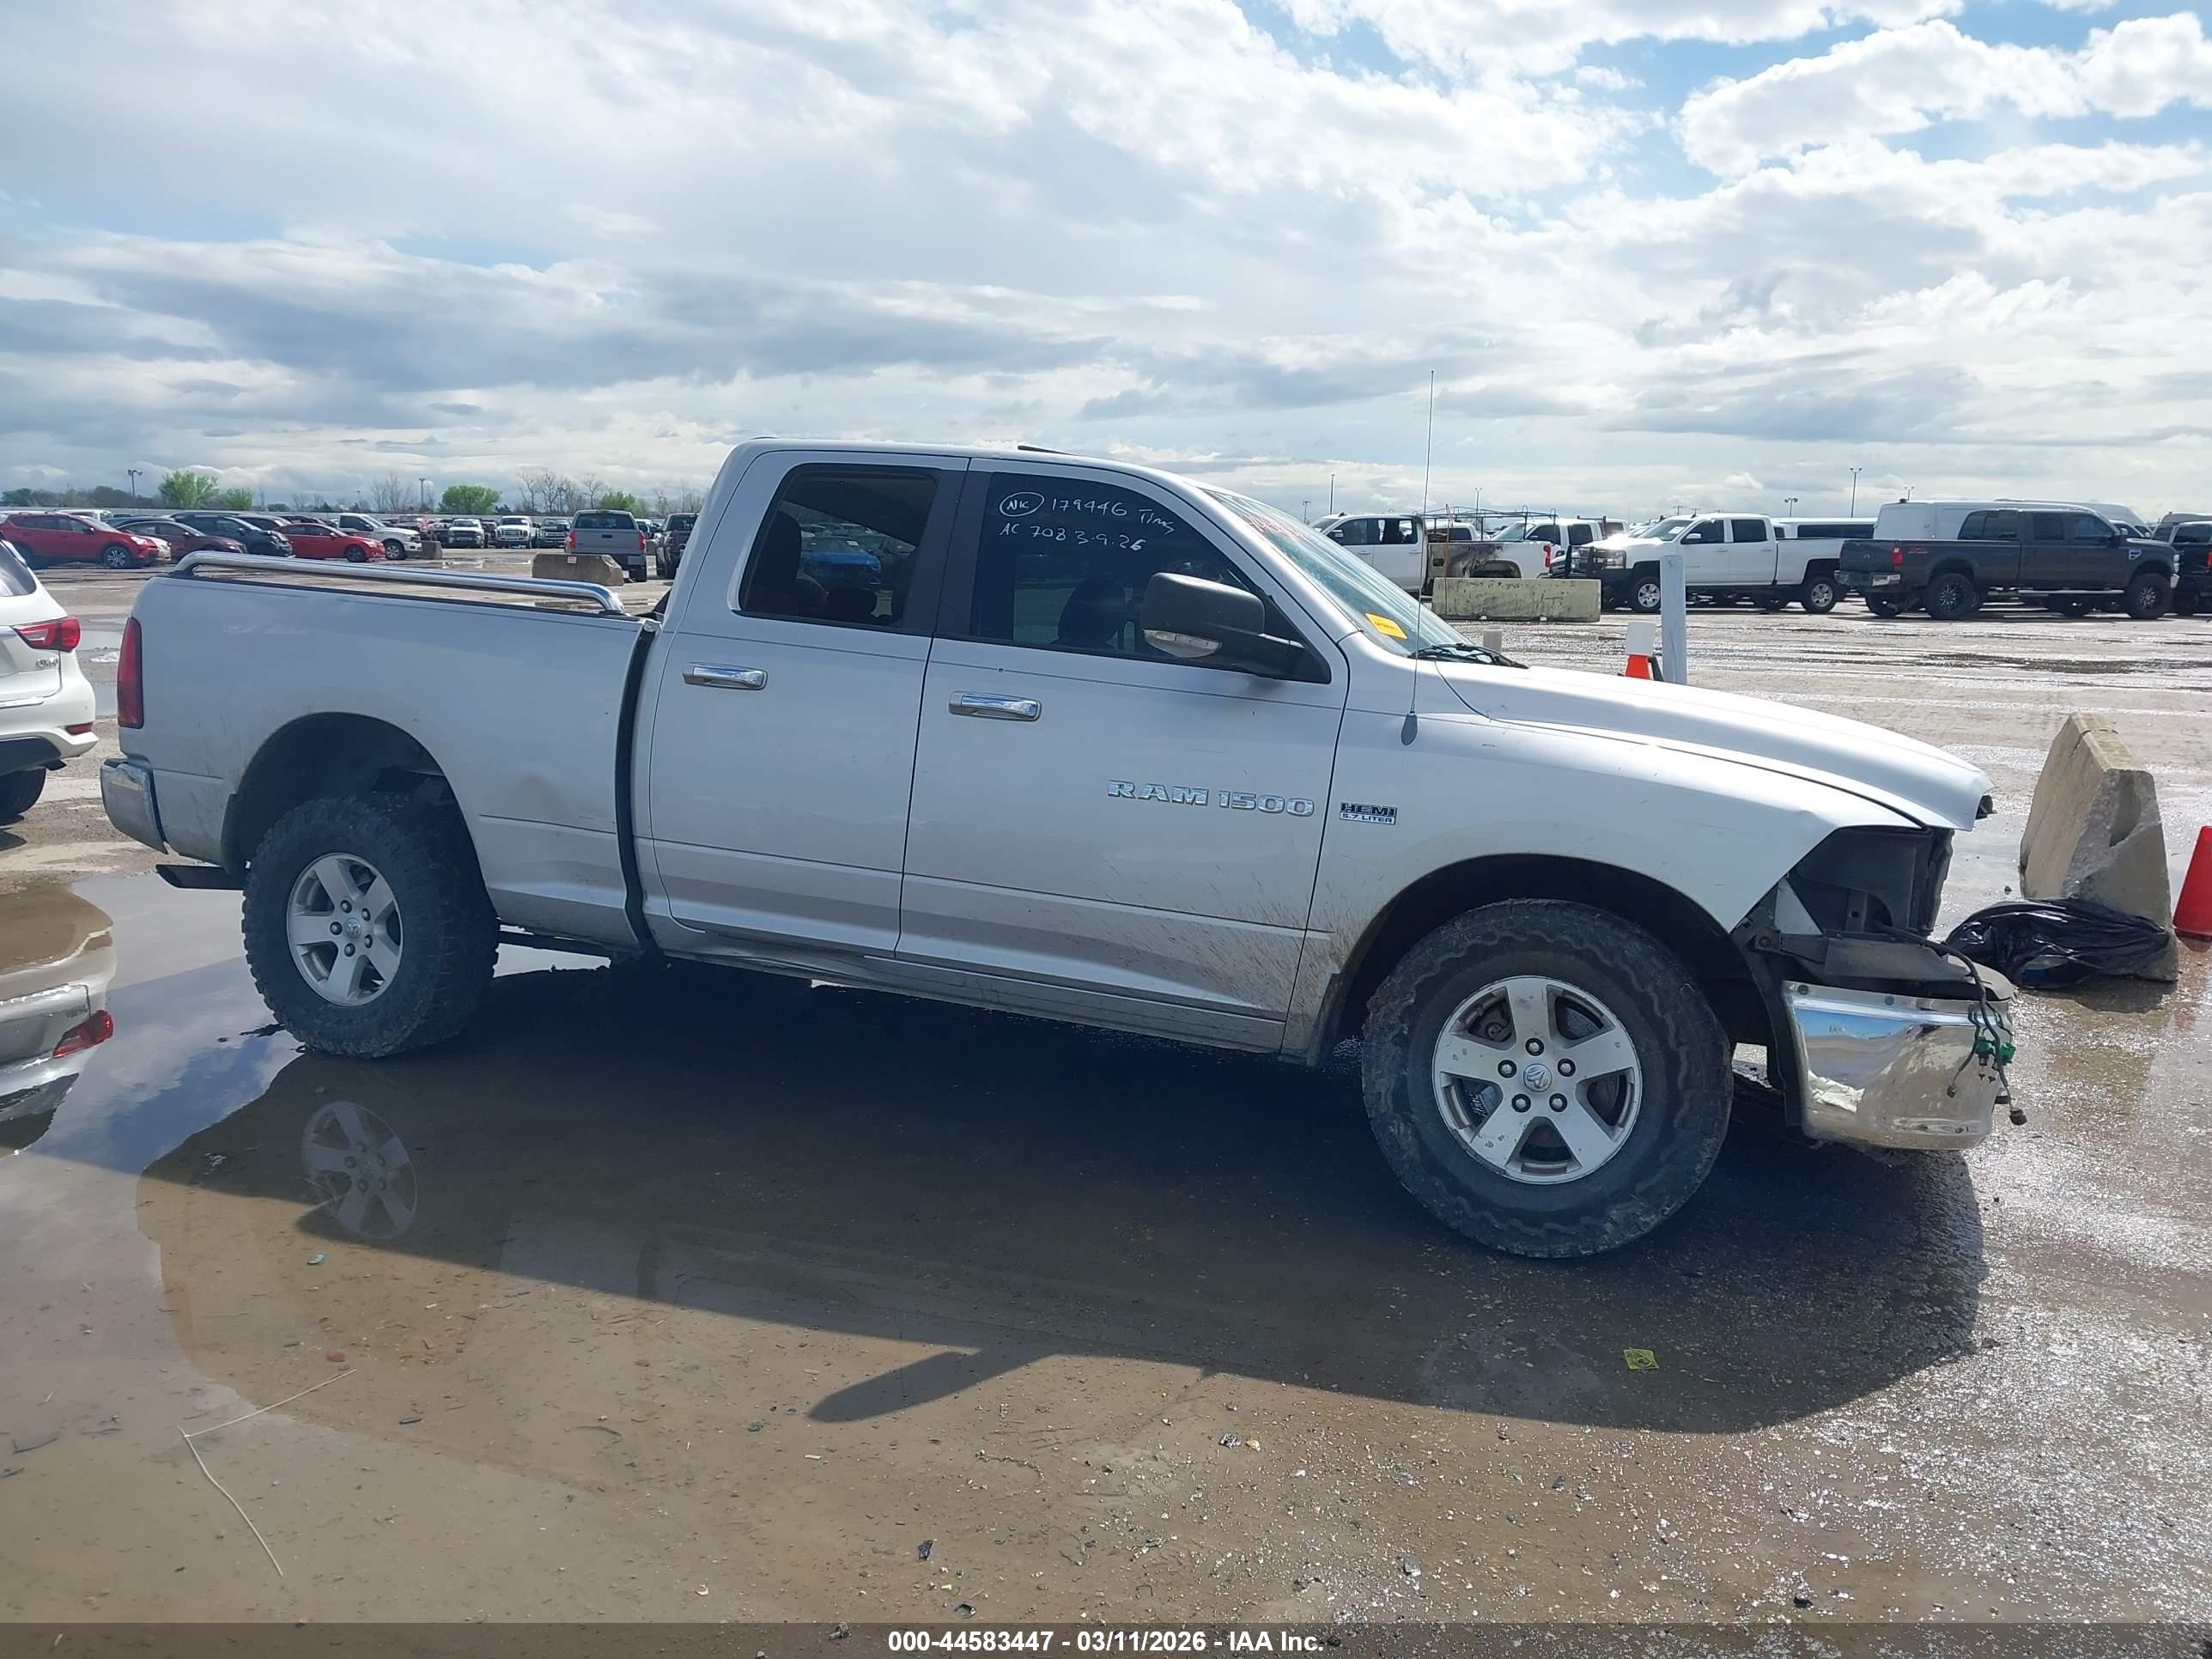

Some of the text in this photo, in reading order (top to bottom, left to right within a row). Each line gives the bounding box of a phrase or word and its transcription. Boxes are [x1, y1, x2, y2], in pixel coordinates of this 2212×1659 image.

[1051, 498, 1128, 516] 179446
[999, 522, 1021, 537] AC
[1108, 779, 1315, 817] RAM 1500
[1340, 802, 1396, 817] HEMI
[1361, 814, 1393, 823] LITER
